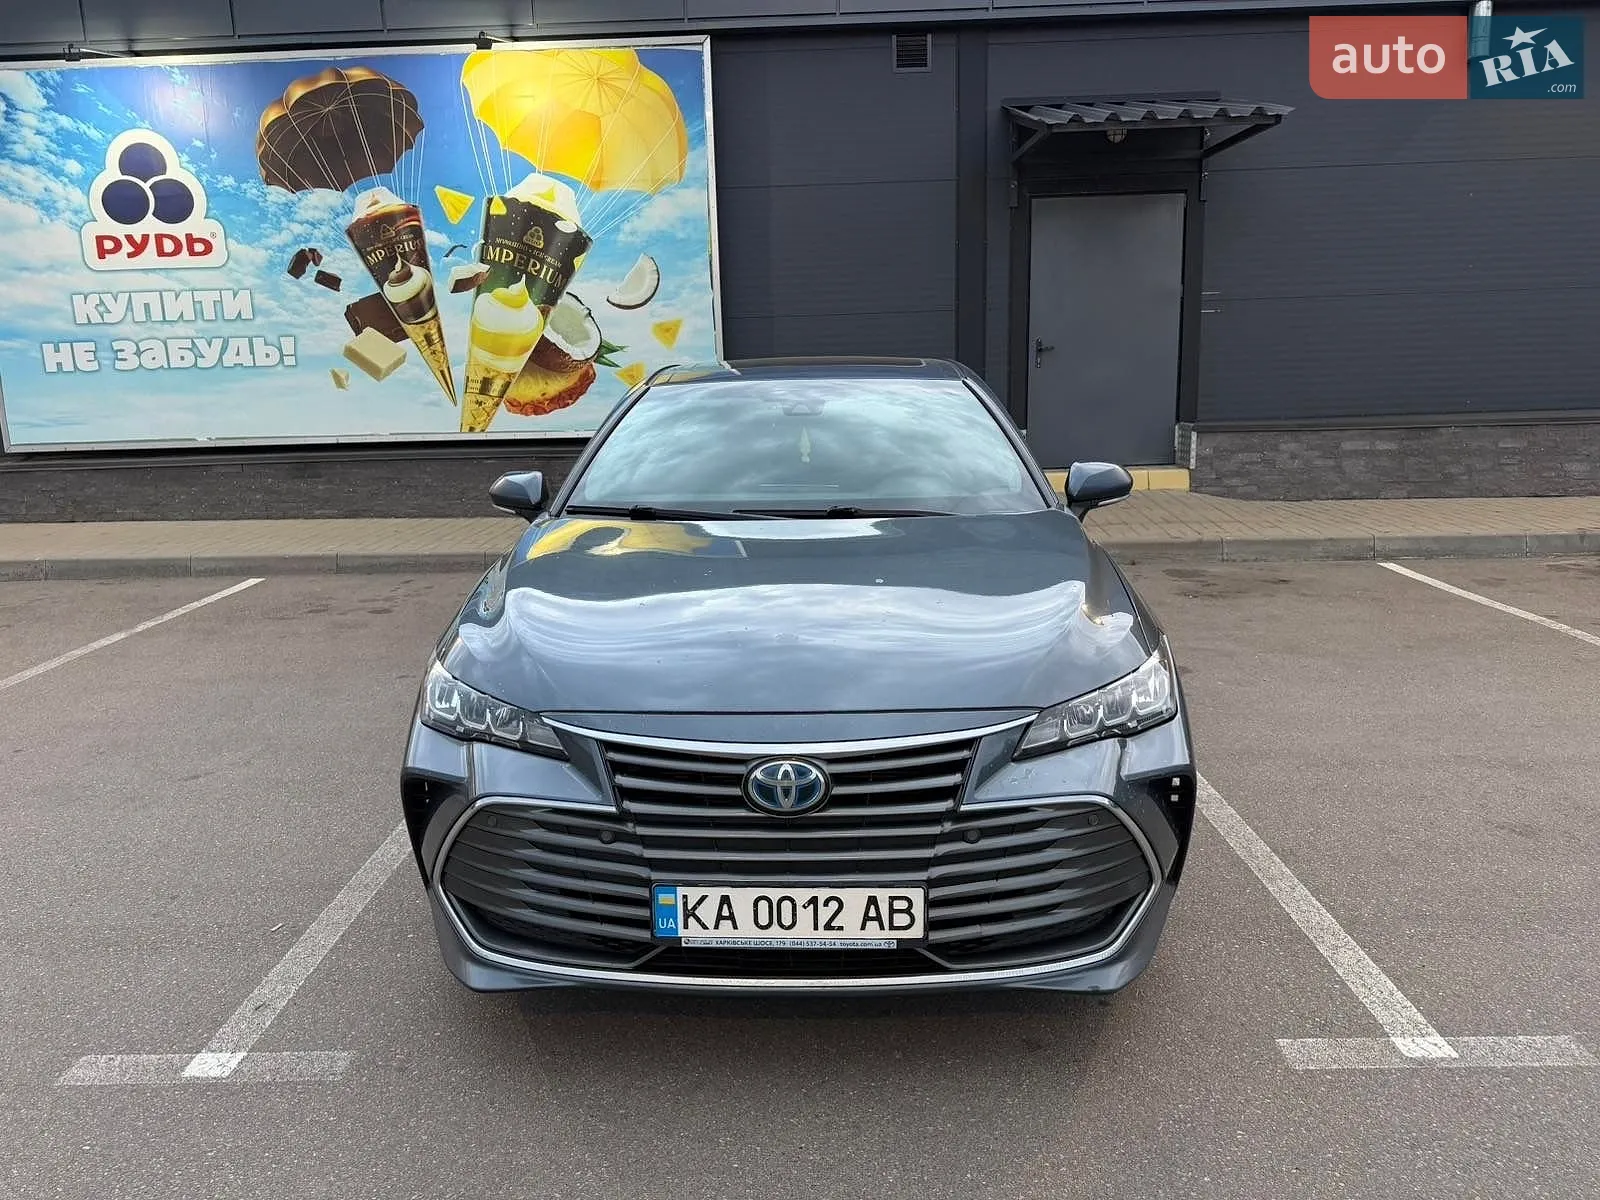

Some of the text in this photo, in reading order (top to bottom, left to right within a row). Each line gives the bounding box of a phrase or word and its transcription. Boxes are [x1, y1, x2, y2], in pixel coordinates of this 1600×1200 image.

[71, 288, 254, 325] КУПИТИ
[42, 341, 100, 373] НЕ
[658, 918, 676, 930] UA
[682, 894, 916, 931] KA 0012 AB
